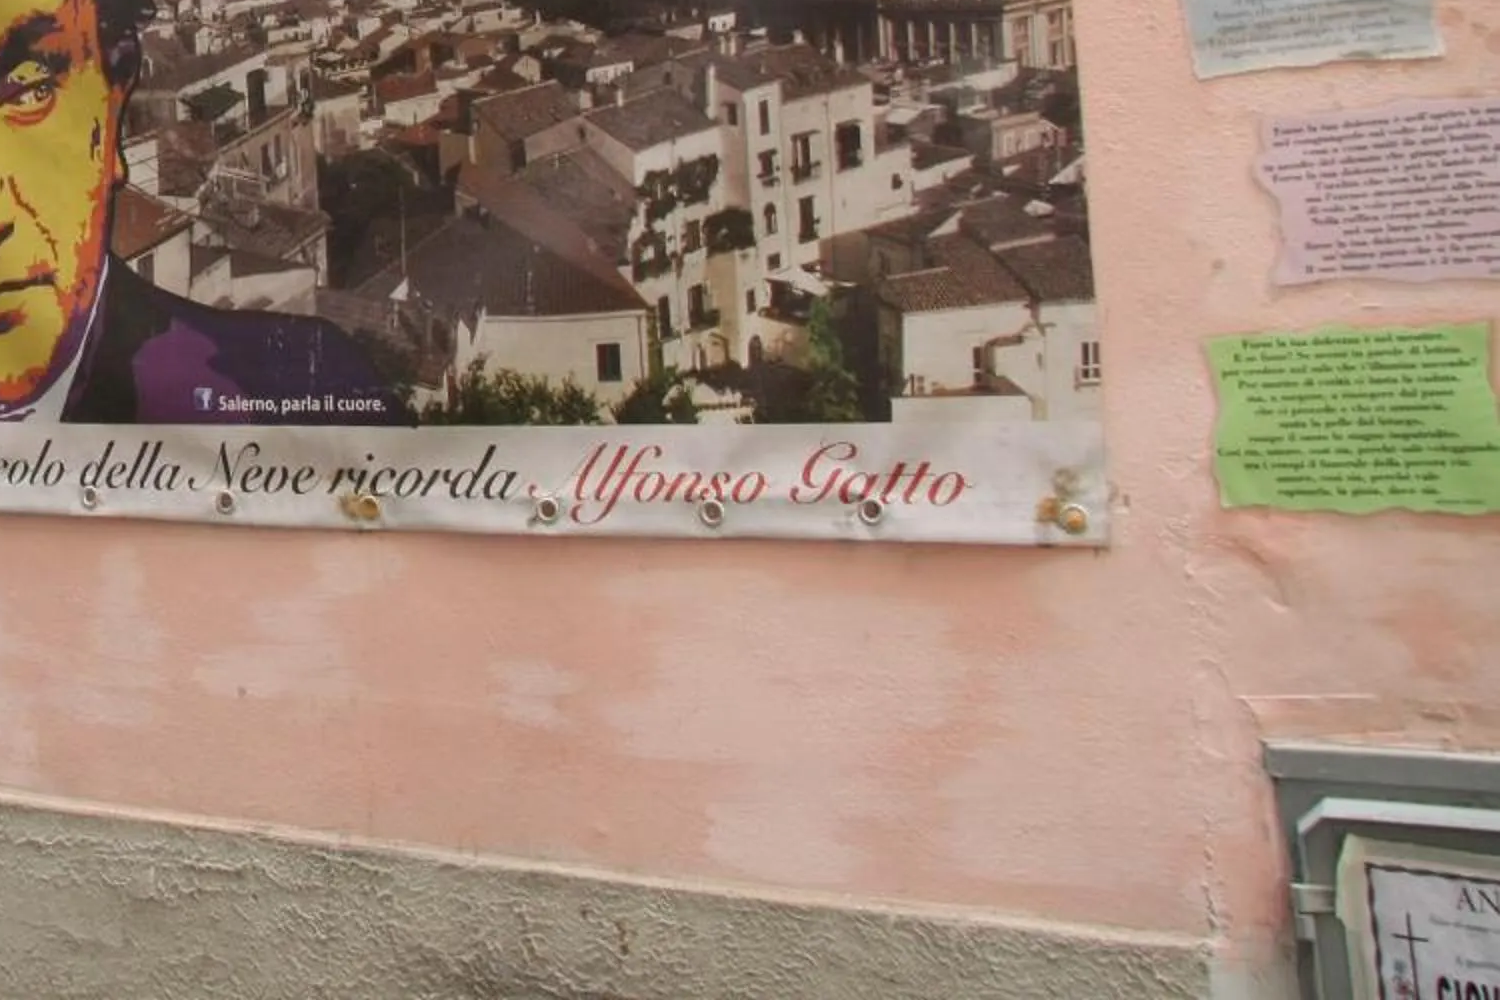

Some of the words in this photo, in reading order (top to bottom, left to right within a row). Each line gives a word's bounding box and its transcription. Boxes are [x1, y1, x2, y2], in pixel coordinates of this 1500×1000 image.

[218, 395, 278, 413] Salerno,
[281, 395, 320, 415] parla
[323, 394, 334, 412] il
[337, 396, 387, 412] cuore.
[78, 441, 182, 492] della
[187, 441, 320, 496] Neve
[326, 444, 518, 502] ricorda
[789, 441, 974, 507] Gatto
